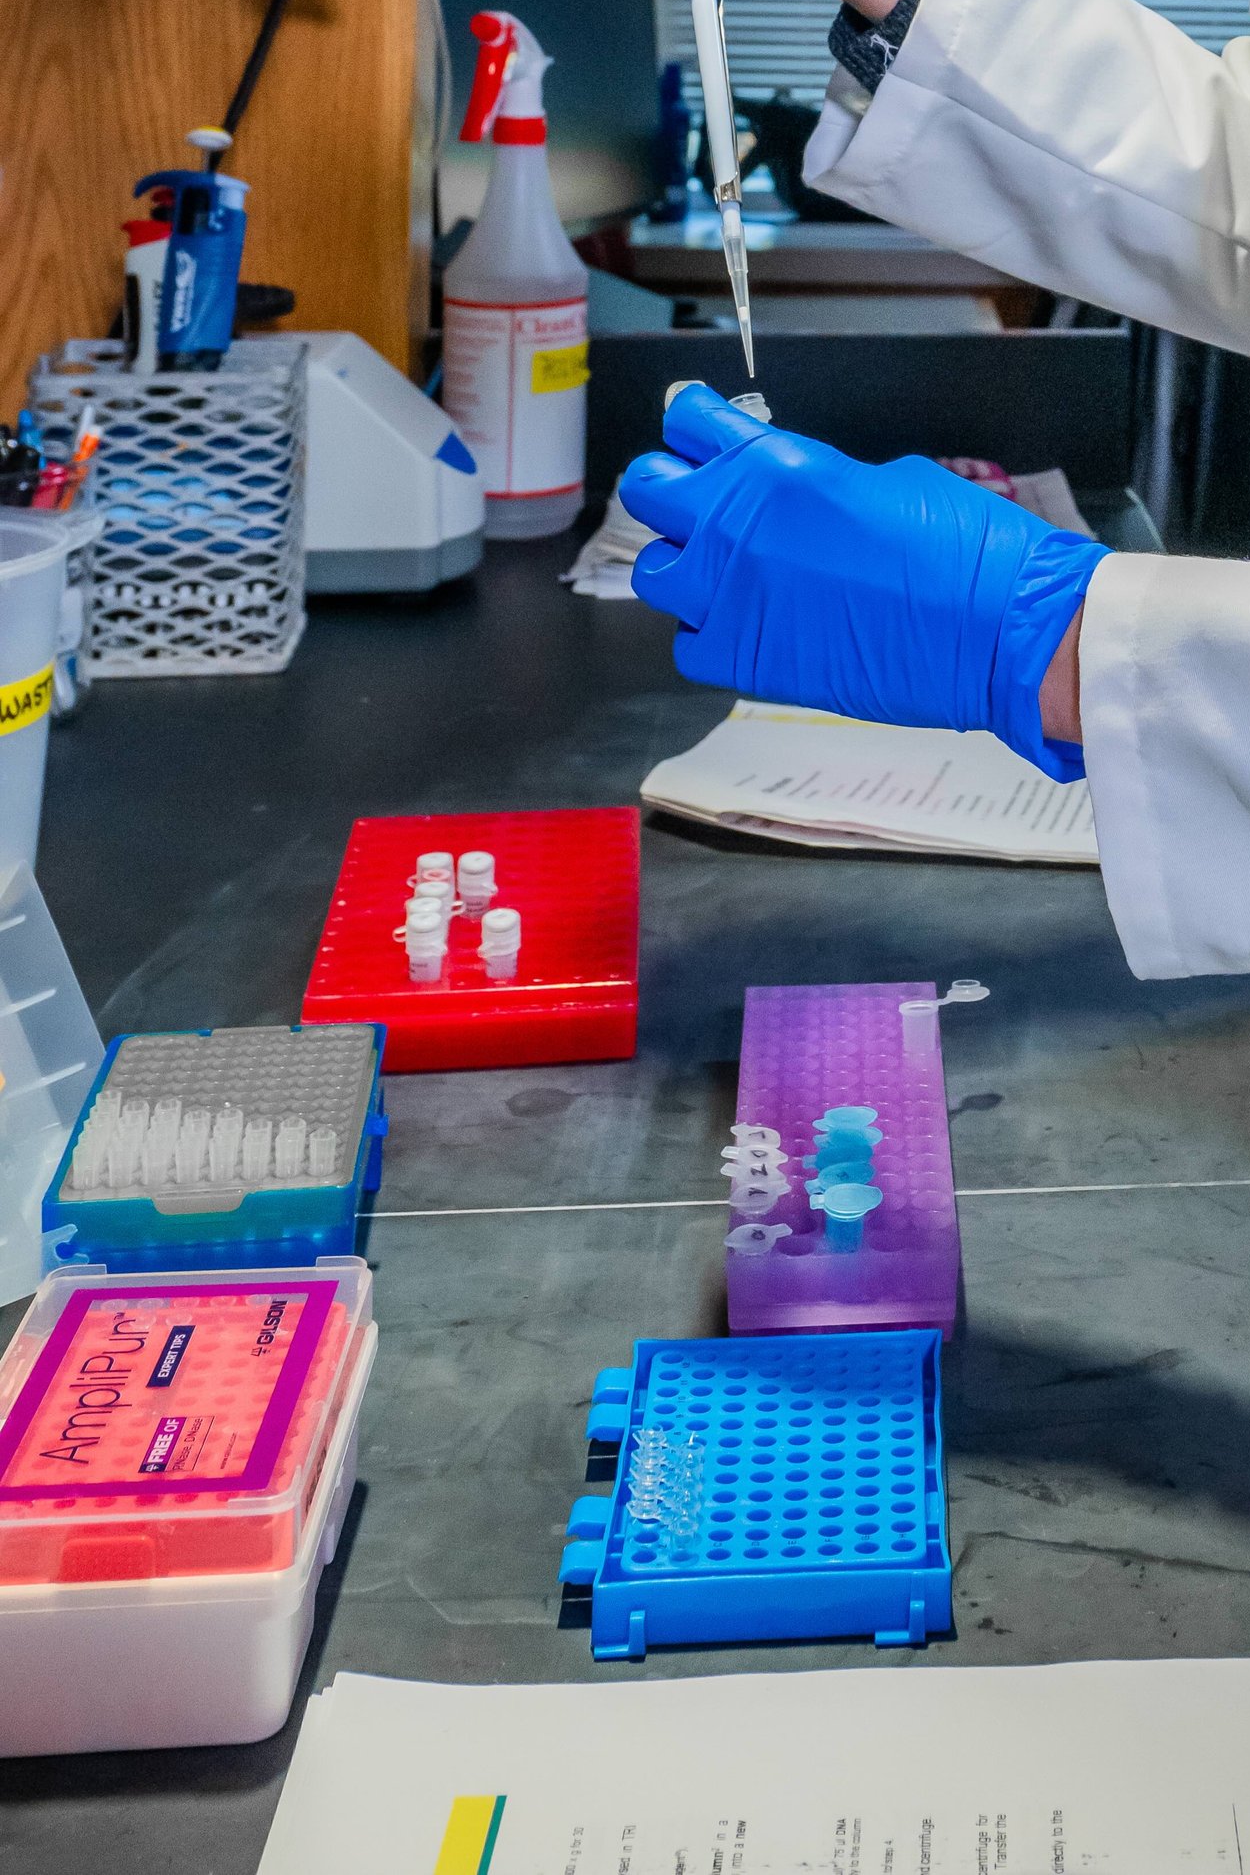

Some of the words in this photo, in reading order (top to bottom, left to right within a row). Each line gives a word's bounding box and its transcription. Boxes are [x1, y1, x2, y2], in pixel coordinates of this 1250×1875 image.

[256, 1300, 288, 1345] GILSON
[157, 1350, 179, 1378] EXPERT
[170, 1333, 186, 1350] TIPS
[184, 1418, 203, 1443] DNase
[147, 1433, 174, 1463] FREE
[163, 1418, 180, 1433] OF
[976, 1814, 988, 1826] for
[995, 1814, 1007, 1828] the
[1050, 1810, 1063, 1824] the
[621, 1824, 637, 1841] TRI
[735, 1820, 747, 1839] new
[835, 1818, 846, 1836] DNA
[1051, 1827, 1063, 1836] to
[994, 1830, 1007, 1870] Transfer
[1051, 1840, 1067, 1874] directly
